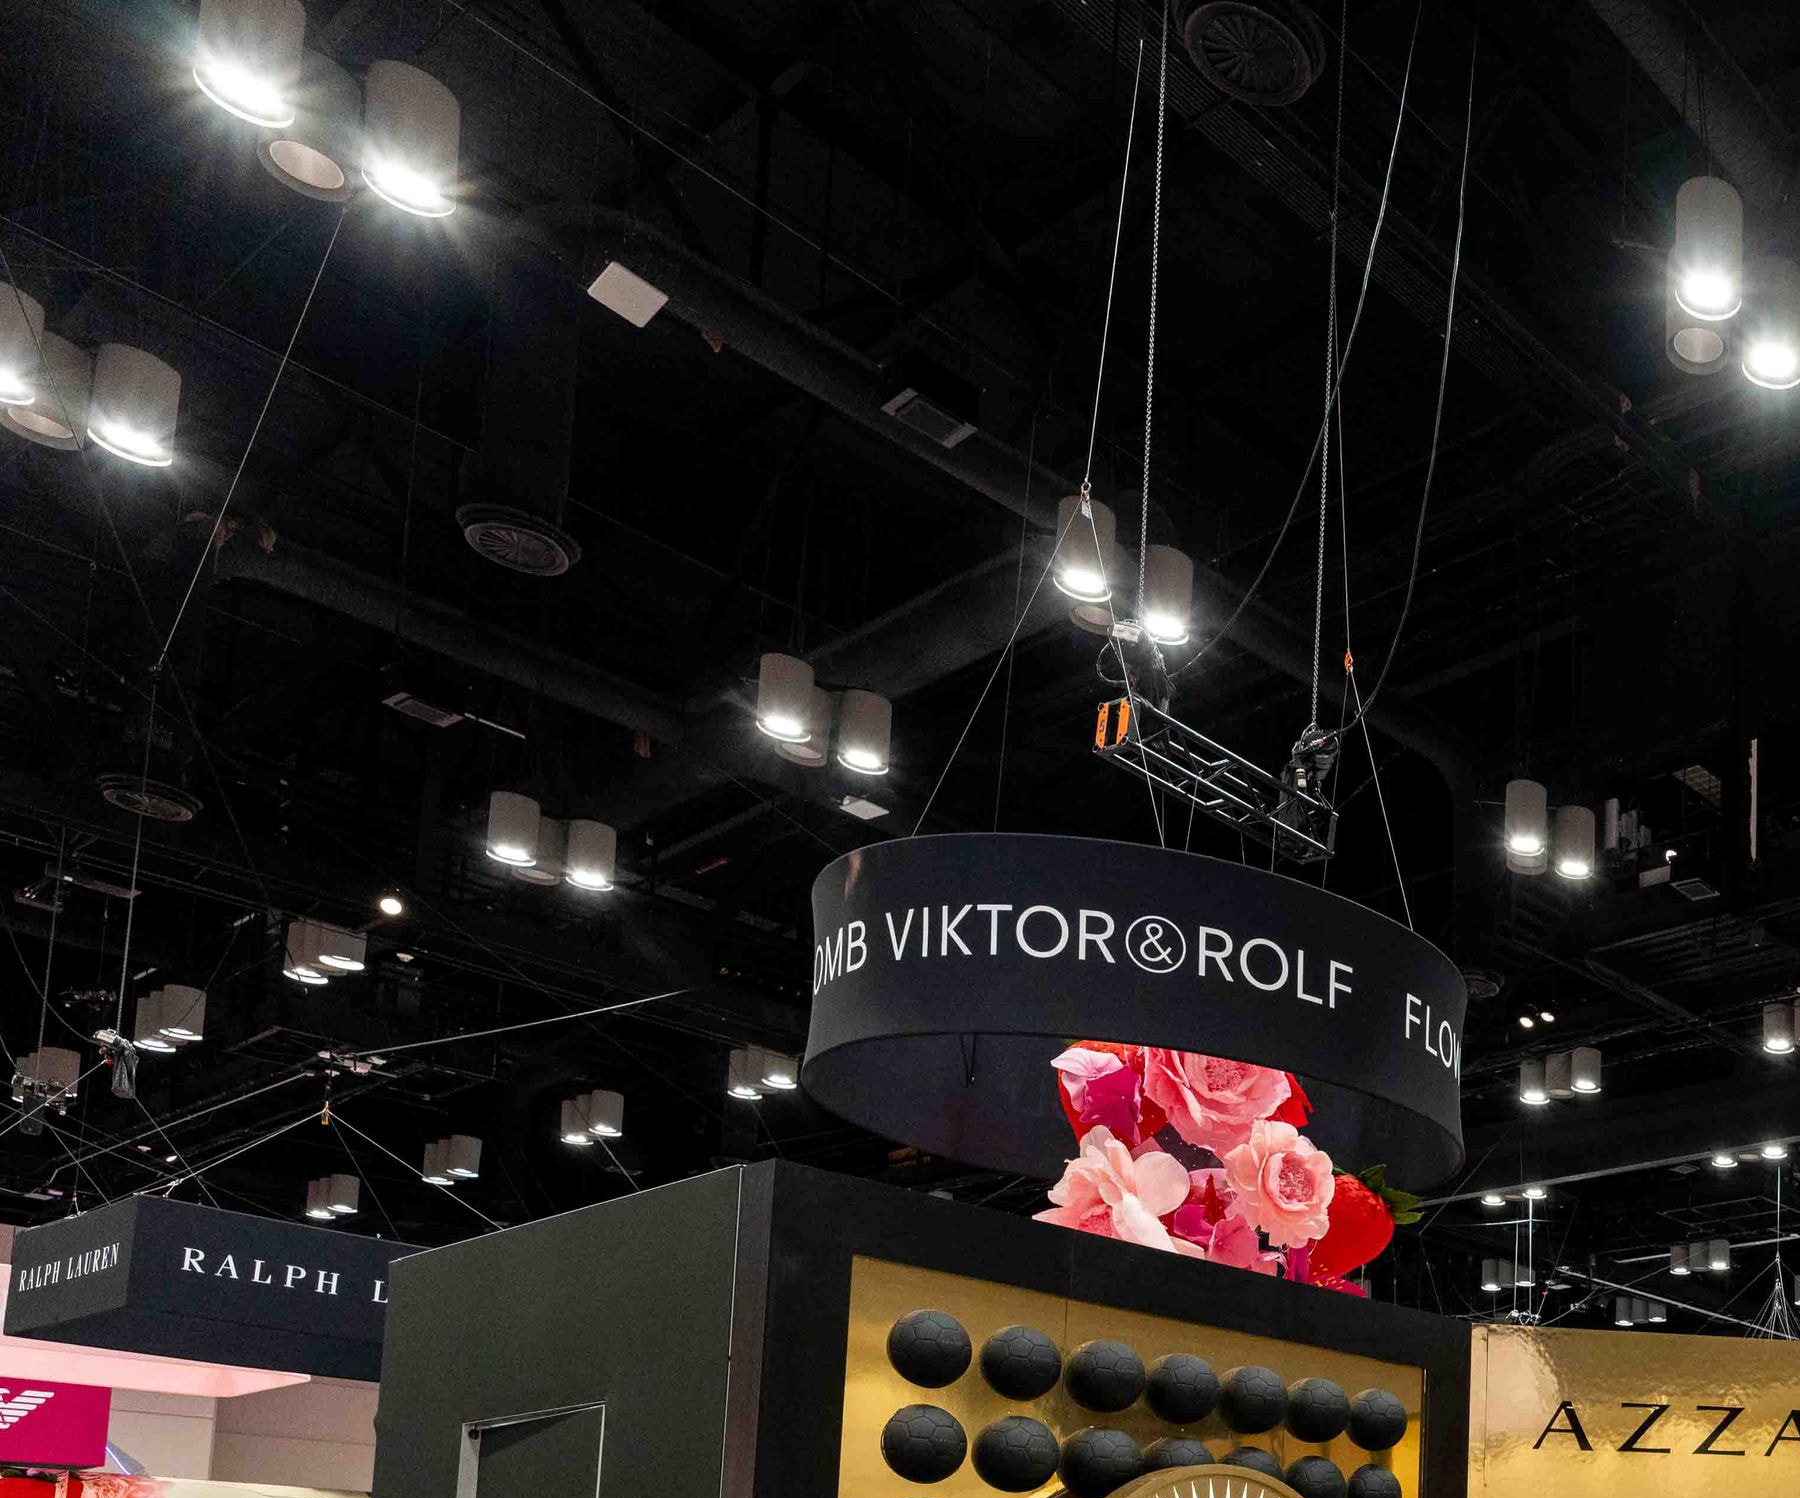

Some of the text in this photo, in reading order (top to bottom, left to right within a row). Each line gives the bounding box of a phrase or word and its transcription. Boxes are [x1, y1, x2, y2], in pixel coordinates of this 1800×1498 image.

[885, 903, 1354, 1010] VIKTOR&ROLF
[18, 1242, 121, 1293] RALPH LAUREN
[180, 1246, 341, 1296] RALPH
